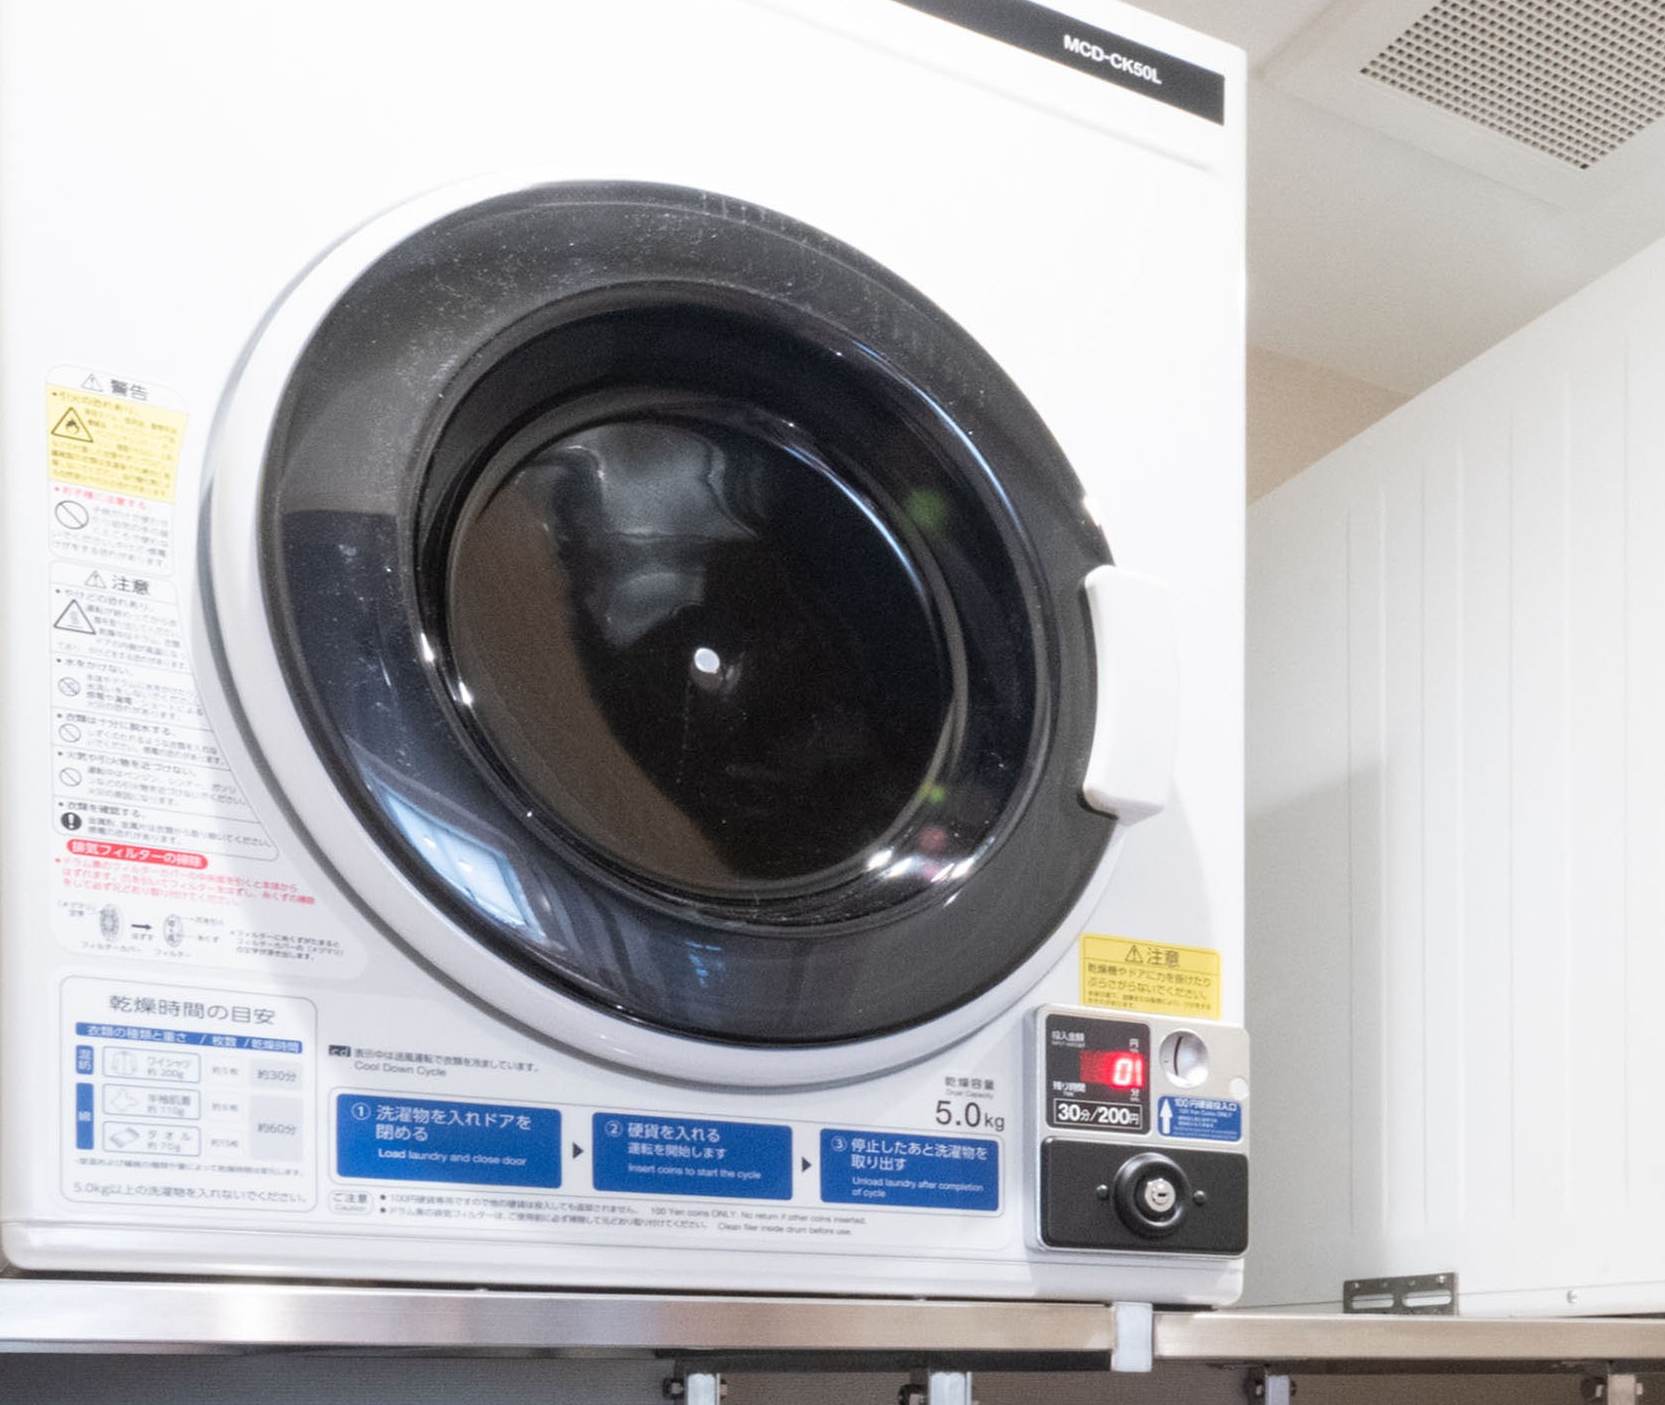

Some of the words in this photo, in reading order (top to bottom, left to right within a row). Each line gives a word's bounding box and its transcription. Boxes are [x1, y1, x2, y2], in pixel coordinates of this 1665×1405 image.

[1062, 33, 1162, 85] MCD-CK50L
[110, 379, 149, 401] 警告
[112, 575, 149, 595] 注意
[1147, 947, 1180, 968] 注意
[109, 995, 276, 1026] 乾燥時間の目安
[257, 1070, 297, 1083] 約30分
[1112, 1057, 1143, 1087] 01
[945, 1076, 995, 1090] 乾燥容量
[376, 1103, 531, 1131] 洗濯物を入れドアを
[1057, 1102, 1140, 1126] 30分/200円
[257, 1122, 297, 1136] 約60分
[375, 1125, 429, 1143] 閉める
[627, 1122, 721, 1143] 硬貨を入れる
[378, 1148, 406, 1160] Load
[472, 1154, 501, 1165] close
[502, 1155, 527, 1166] door
[627, 1142, 728, 1160] 運転を開始します
[851, 1138, 988, 1161] 停止したあと洗濯物を
[851, 1155, 907, 1171] 取り出す
[737, 1170, 762, 1181] cycle
[863, 1189, 887, 1200] cycle
[938, 1182, 984, 1192] completion
[333, 1192, 367, 1203] ご注意
